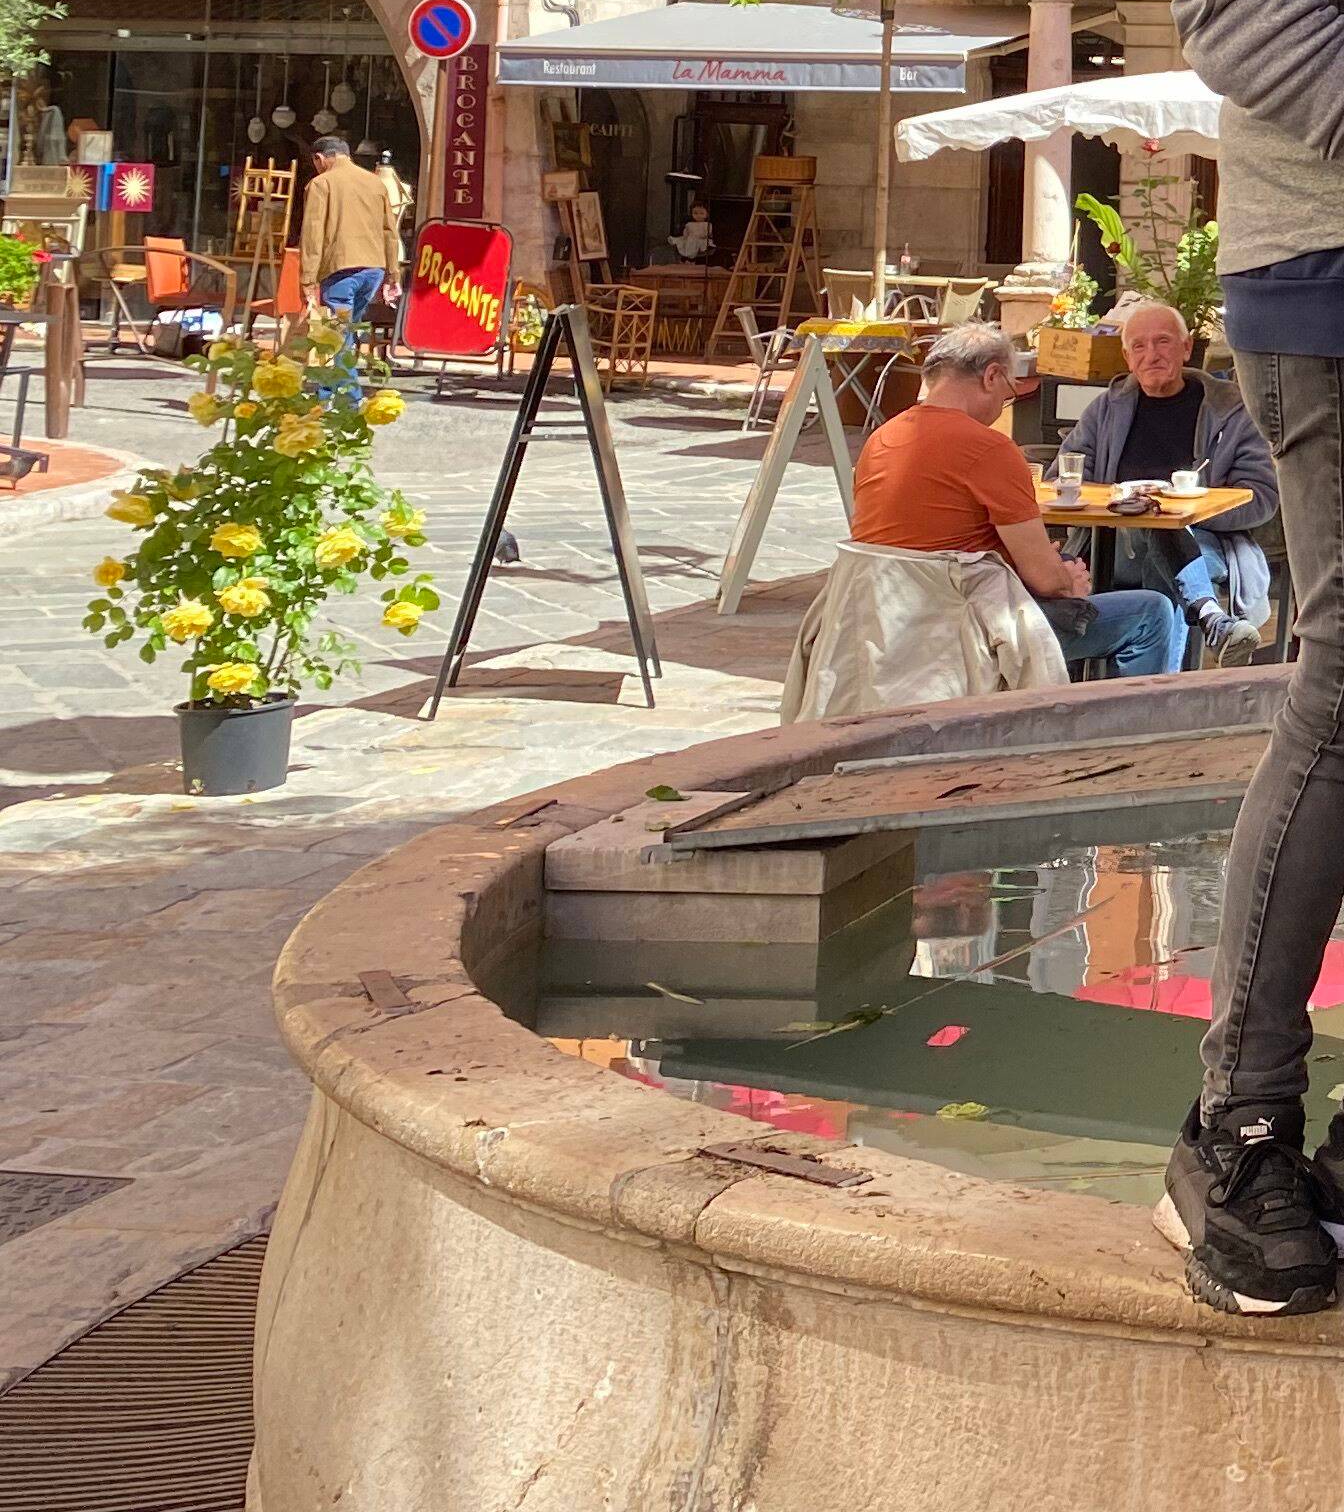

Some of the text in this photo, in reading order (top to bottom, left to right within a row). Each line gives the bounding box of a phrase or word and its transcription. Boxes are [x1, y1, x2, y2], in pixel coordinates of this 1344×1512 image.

[543, 59, 596, 76] Restaurant
[698, 59, 787, 81] Mamma
[899, 67, 917, 81] Bar
[452, 55, 479, 205] BROCANTE
[418, 244, 500, 332] BROCANTE
